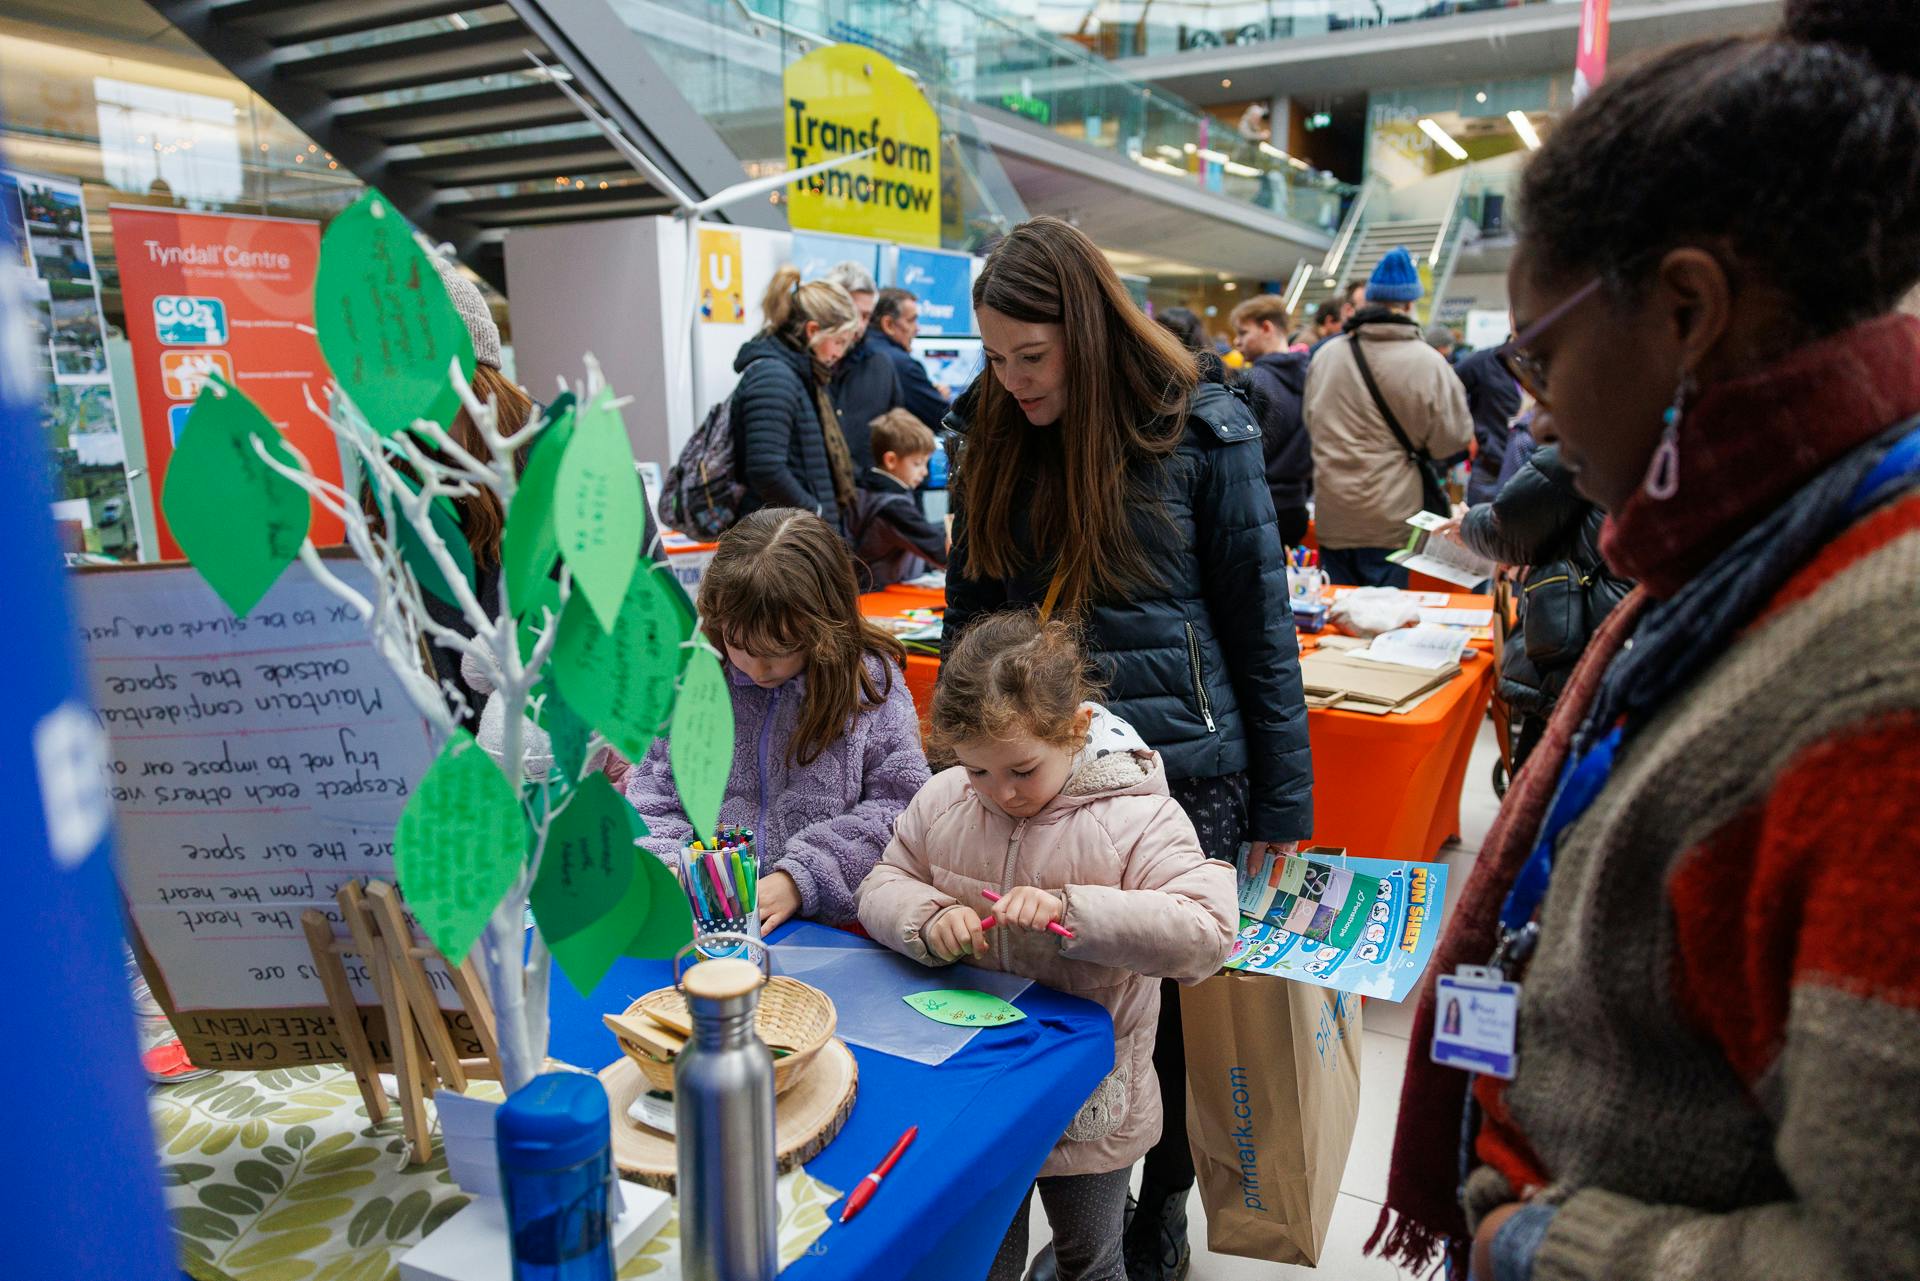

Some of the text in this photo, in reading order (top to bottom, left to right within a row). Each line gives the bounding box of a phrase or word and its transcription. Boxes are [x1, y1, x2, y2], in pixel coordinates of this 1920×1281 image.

[790, 98, 931, 174] Transform
[791, 147, 933, 213] Tomorrow
[144, 240, 291, 270] Tyndall Centre
[709, 252, 732, 291] U
[135, 617, 175, 637] and
[255, 612, 286, 628] be
[292, 608, 316, 625] to
[104, 658, 350, 694] outside the space
[94, 687, 384, 730] Maintain confidential
[186, 738, 260, 776] impose
[338, 727, 380, 771] try
[139, 760, 174, 778] our
[266, 755, 291, 773] to
[299, 751, 335, 770] not
[244, 783, 301, 801] each
[315, 768, 409, 799] Respect
[180, 833, 247, 860] space
[261, 843, 297, 862] air
[306, 840, 347, 862] the
[157, 886, 214, 905] heart
[219, 885, 261, 904] the
[268, 872, 314, 899] from
[176, 910, 242, 932] heart
[251, 909, 294, 931] the
[1339, 900, 1361, 937] Pensthorpe
[1400, 867, 1429, 955] FUN SHEET
[248, 965, 286, 980] are
[203, 1041, 278, 1062] CAFE
[1232, 1066, 1268, 1212] primark.com
